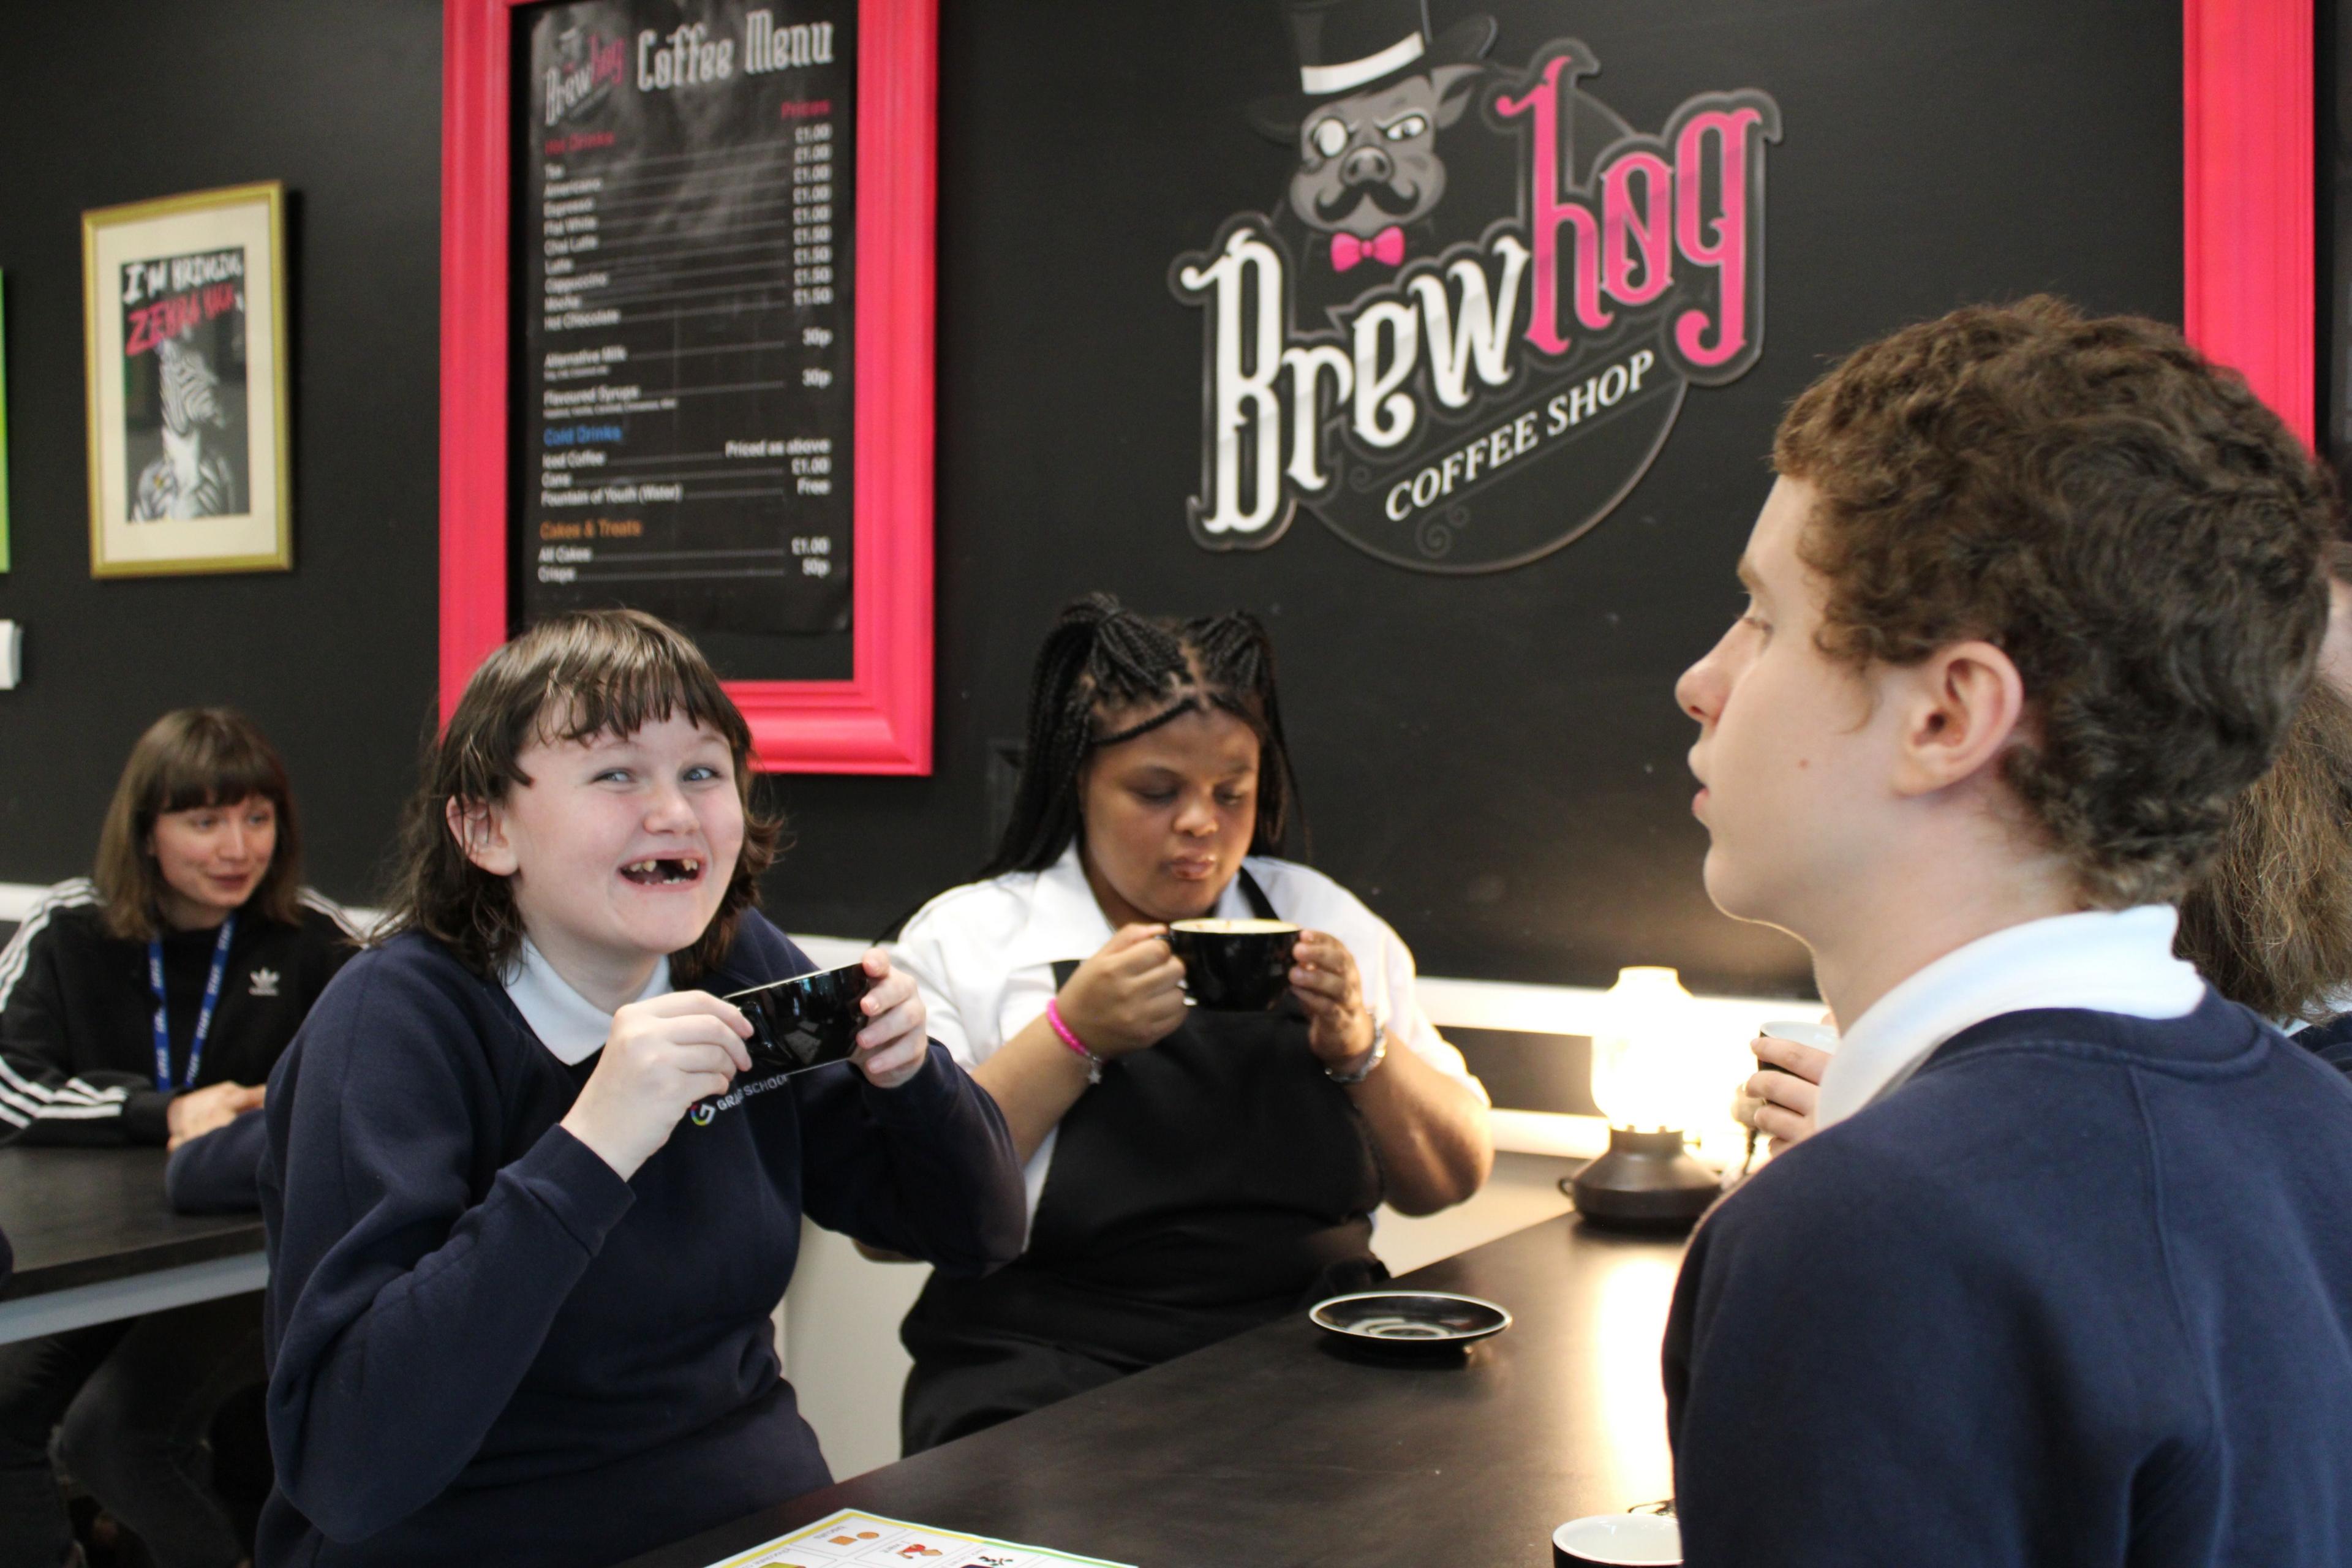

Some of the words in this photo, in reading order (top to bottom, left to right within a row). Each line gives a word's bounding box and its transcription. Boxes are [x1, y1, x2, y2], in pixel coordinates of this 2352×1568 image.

[637, 23, 734, 91] Coffee
[745, 9, 834, 74] Menu
[545, 428, 574, 446] Cold
[577, 426, 623, 443] Drinks
[1385, 412, 1539, 522] COFFEE
[1546, 348, 1656, 436] SHOP
[567, 451, 607, 469] Coffee
[725, 440, 766, 459] Priced
[767, 442, 785, 457] as
[787, 438, 831, 456] above
[791, 456, 832, 475] £1.00
[797, 478, 831, 495] Free
[540, 521, 581, 541] Cakes
[584, 521, 594, 538] &
[598, 519, 643, 537] Treats
[791, 537, 831, 556] £1.00
[802, 557, 831, 578] 50p
